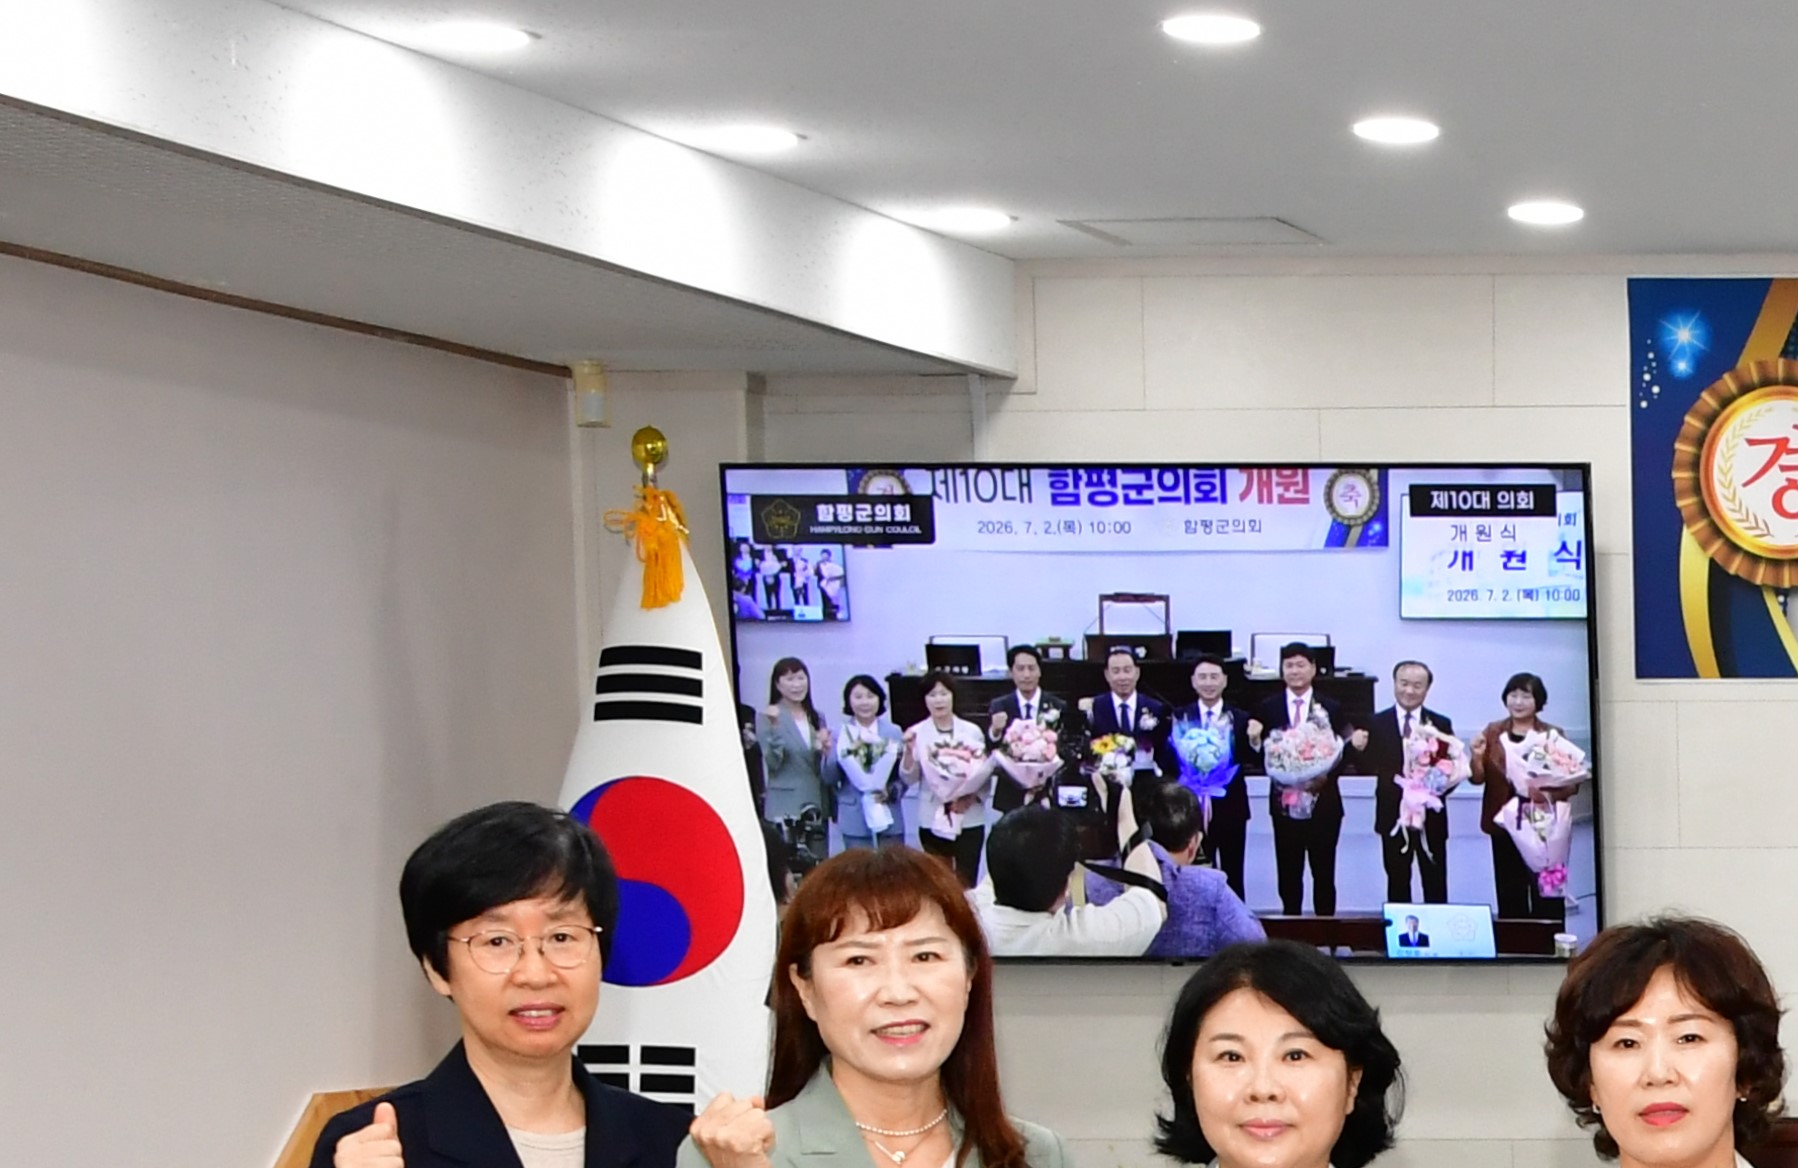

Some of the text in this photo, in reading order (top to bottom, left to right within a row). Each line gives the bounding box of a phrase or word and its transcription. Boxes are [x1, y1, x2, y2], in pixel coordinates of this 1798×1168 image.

[1430, 490, 1535, 510] 제10대 의회
[816, 503, 911, 522] 함평군의회
[1090, 520, 1132, 535] 10:00
[1184, 518, 1262, 535] 함평군의회
